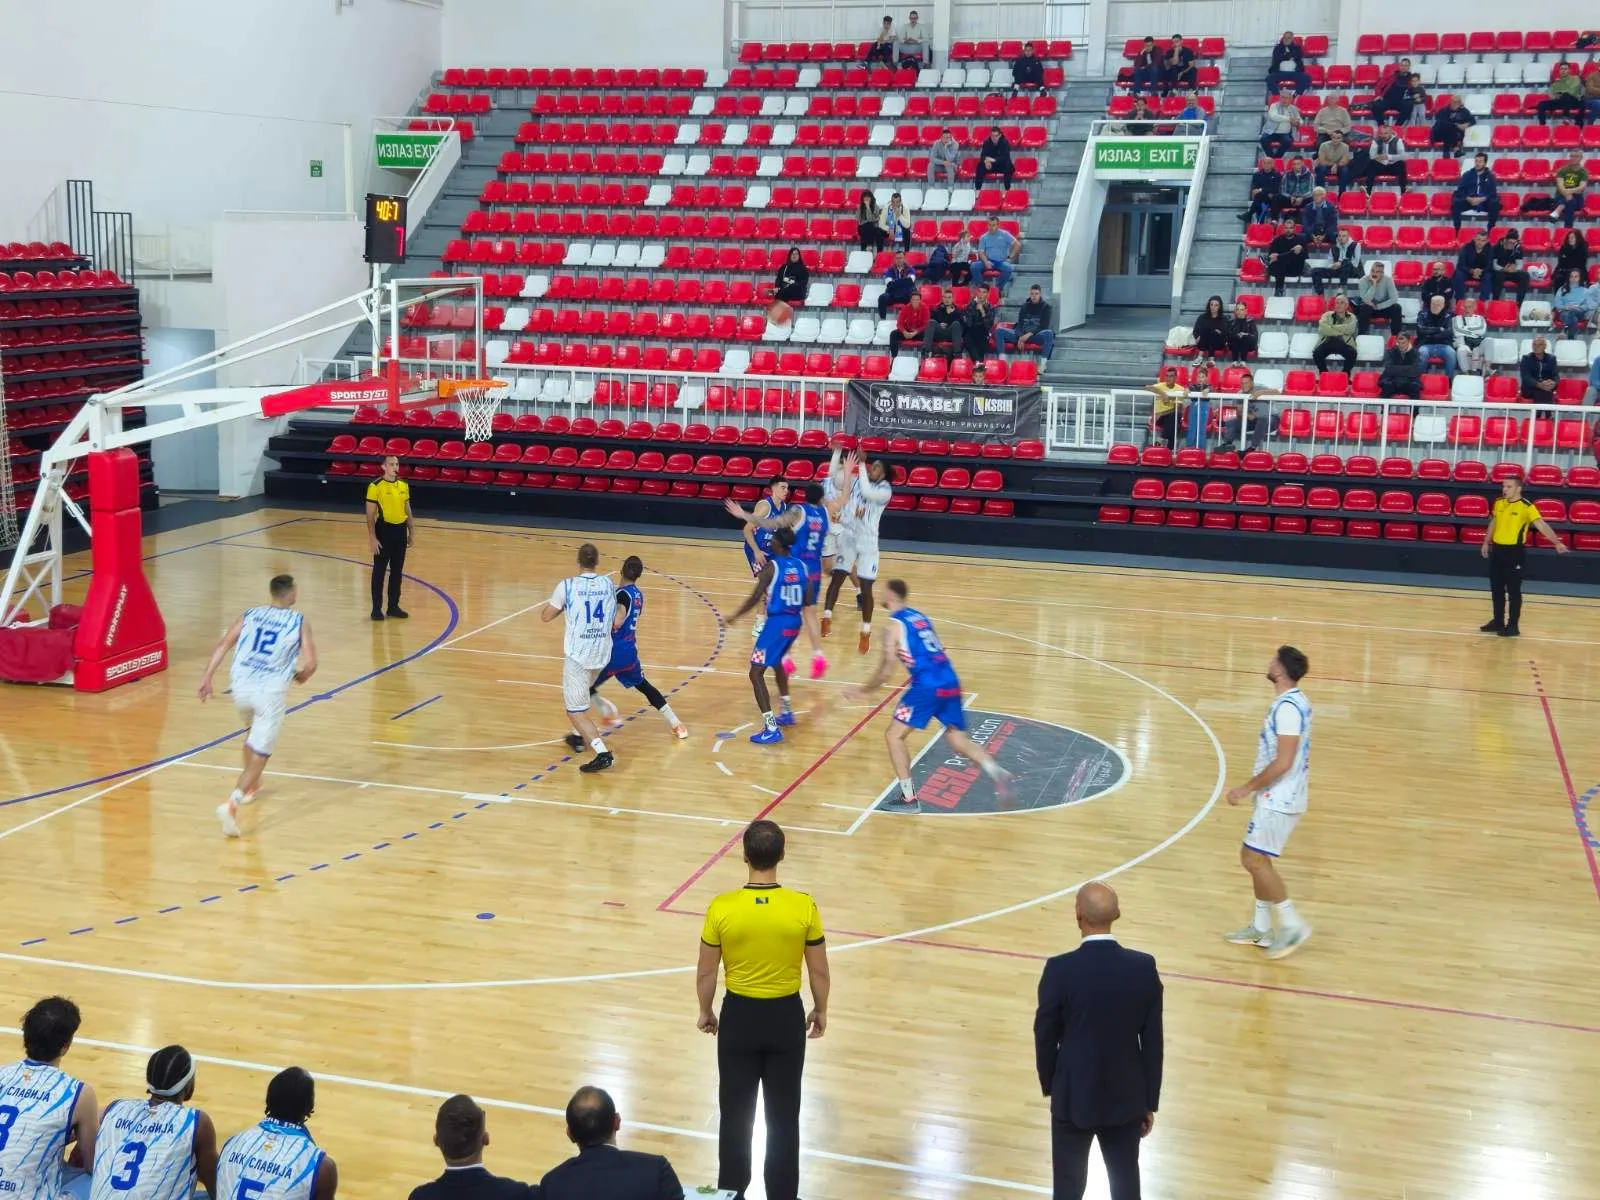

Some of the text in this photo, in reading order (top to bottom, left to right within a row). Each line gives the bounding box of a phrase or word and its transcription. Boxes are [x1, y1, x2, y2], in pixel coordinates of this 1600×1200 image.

[378, 143, 412, 158] ИЗЛАЗ
[414, 144, 441, 158] EXIT
[1099, 149, 1141, 163] ИЗЛАЗ
[1149, 149, 1179, 163] EXIT
[984, 398, 1013, 413] KSBIH
[873, 416, 912, 425] PREMIUM
[961, 422, 1011, 430] PRVENSTVA
[780, 584, 803, 606] 40
[584, 599, 605, 624] 14
[252, 627, 279, 655] 12
[944, 719, 1002, 767] Pruction
[7, 1086, 51, 1103] СЛАВИЈА
[115, 1118, 134, 1130] ОКК
[110, 1141, 148, 1190] 3
[228, 1151, 293, 1179] ОКК СЛАВИЈА
